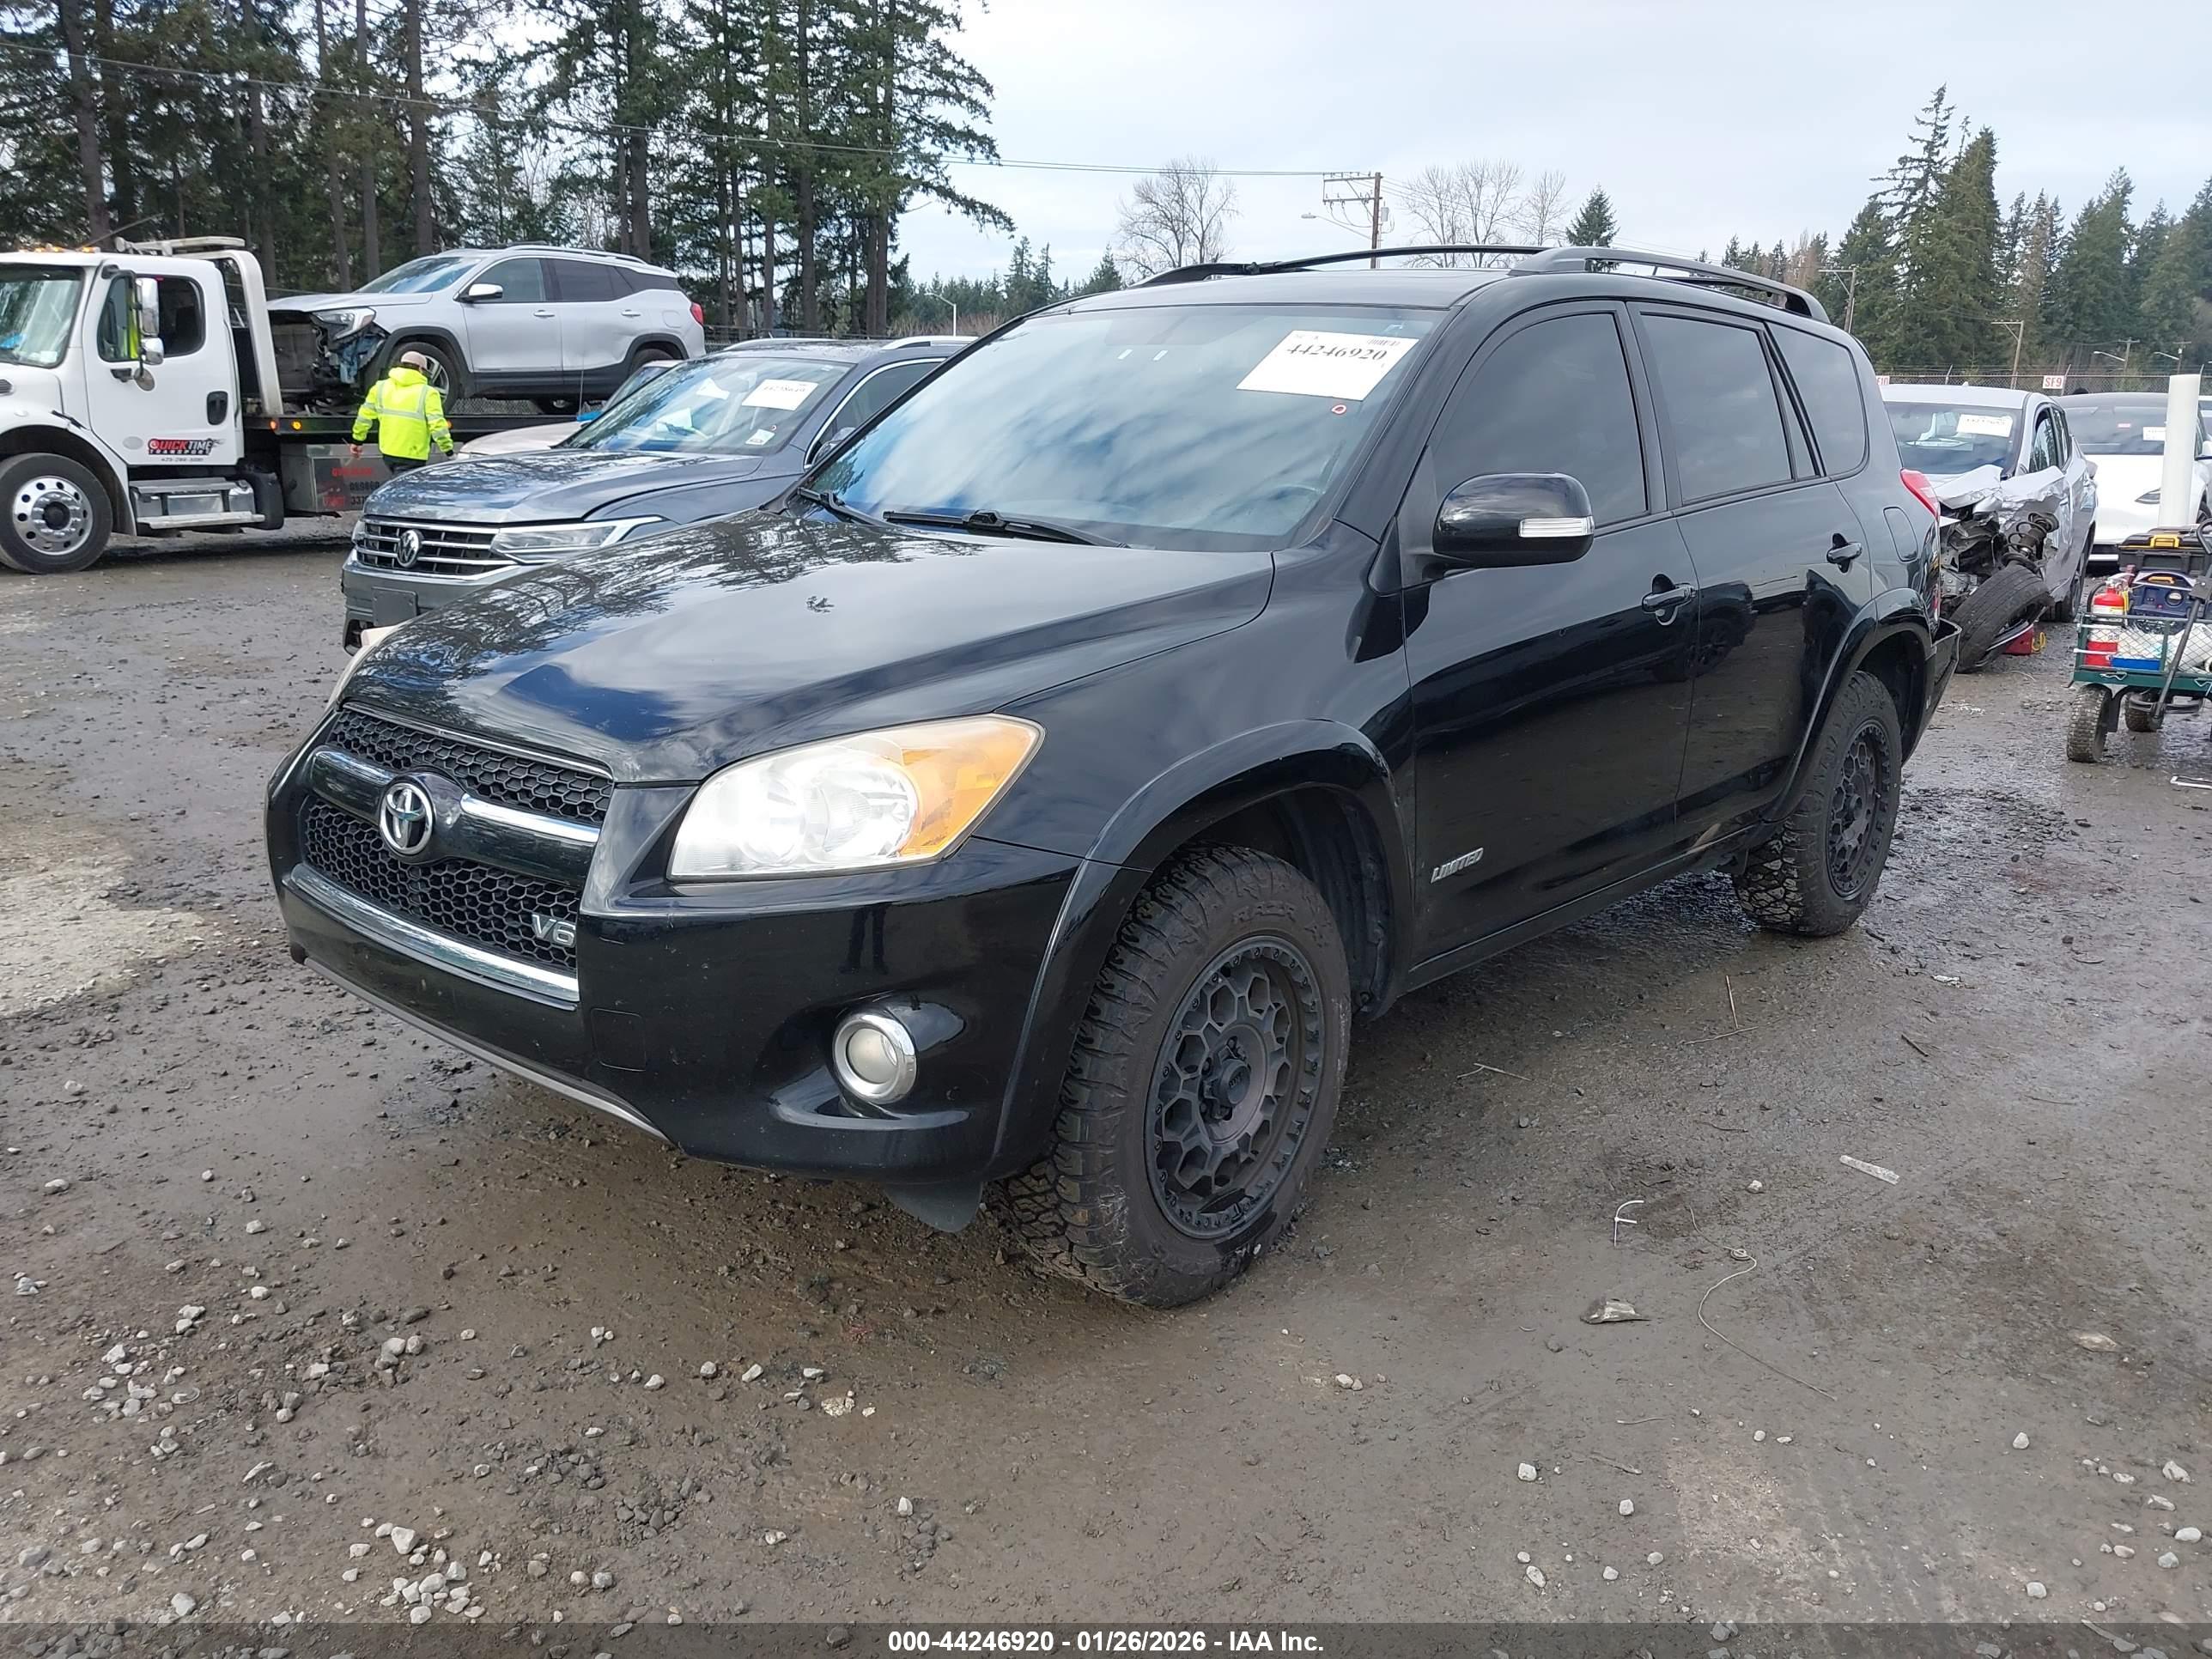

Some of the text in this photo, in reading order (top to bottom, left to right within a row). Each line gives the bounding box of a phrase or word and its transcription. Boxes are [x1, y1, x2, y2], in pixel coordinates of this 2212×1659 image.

[1286, 343, 1388, 361] 44246920
[1876, 376, 1889, 386] F10
[2045, 377, 2061, 387] SF9
[1431, 847, 1484, 884] LIMITED
[532, 914, 576, 947] V6
